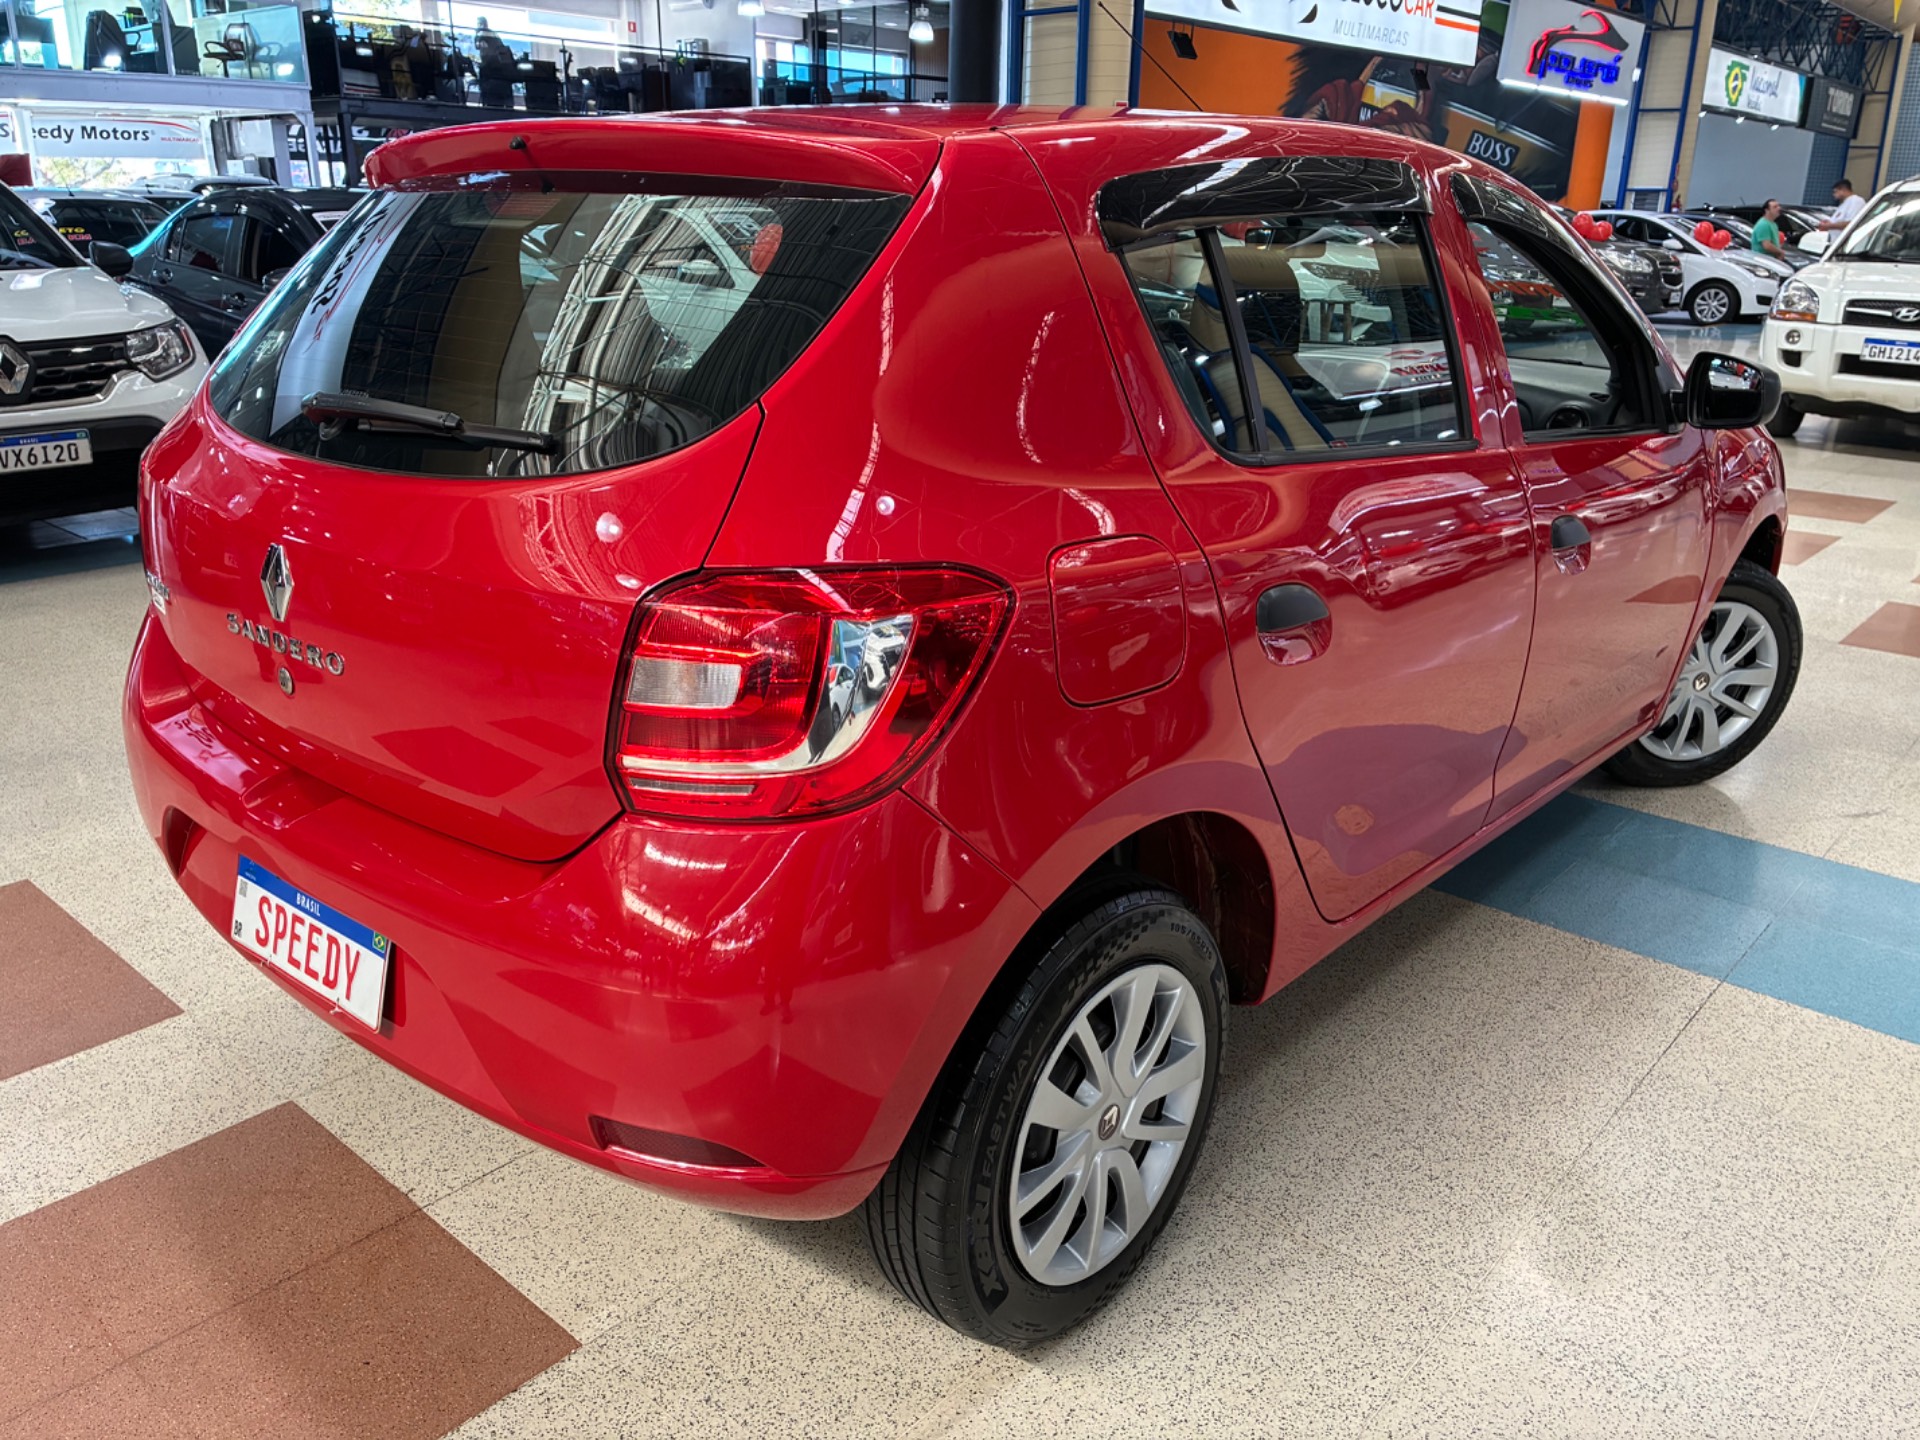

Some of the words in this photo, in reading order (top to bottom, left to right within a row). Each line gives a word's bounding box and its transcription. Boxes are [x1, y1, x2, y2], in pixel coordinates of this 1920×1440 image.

[1333, 19, 1410, 46] MULTIMARCAS
[81, 125, 150, 141] Motors
[1468, 132, 1516, 167] BOSS
[226, 612, 345, 676] SANDERO
[296, 891, 321, 917] BRASIL
[255, 895, 361, 1001] SPEEDY
